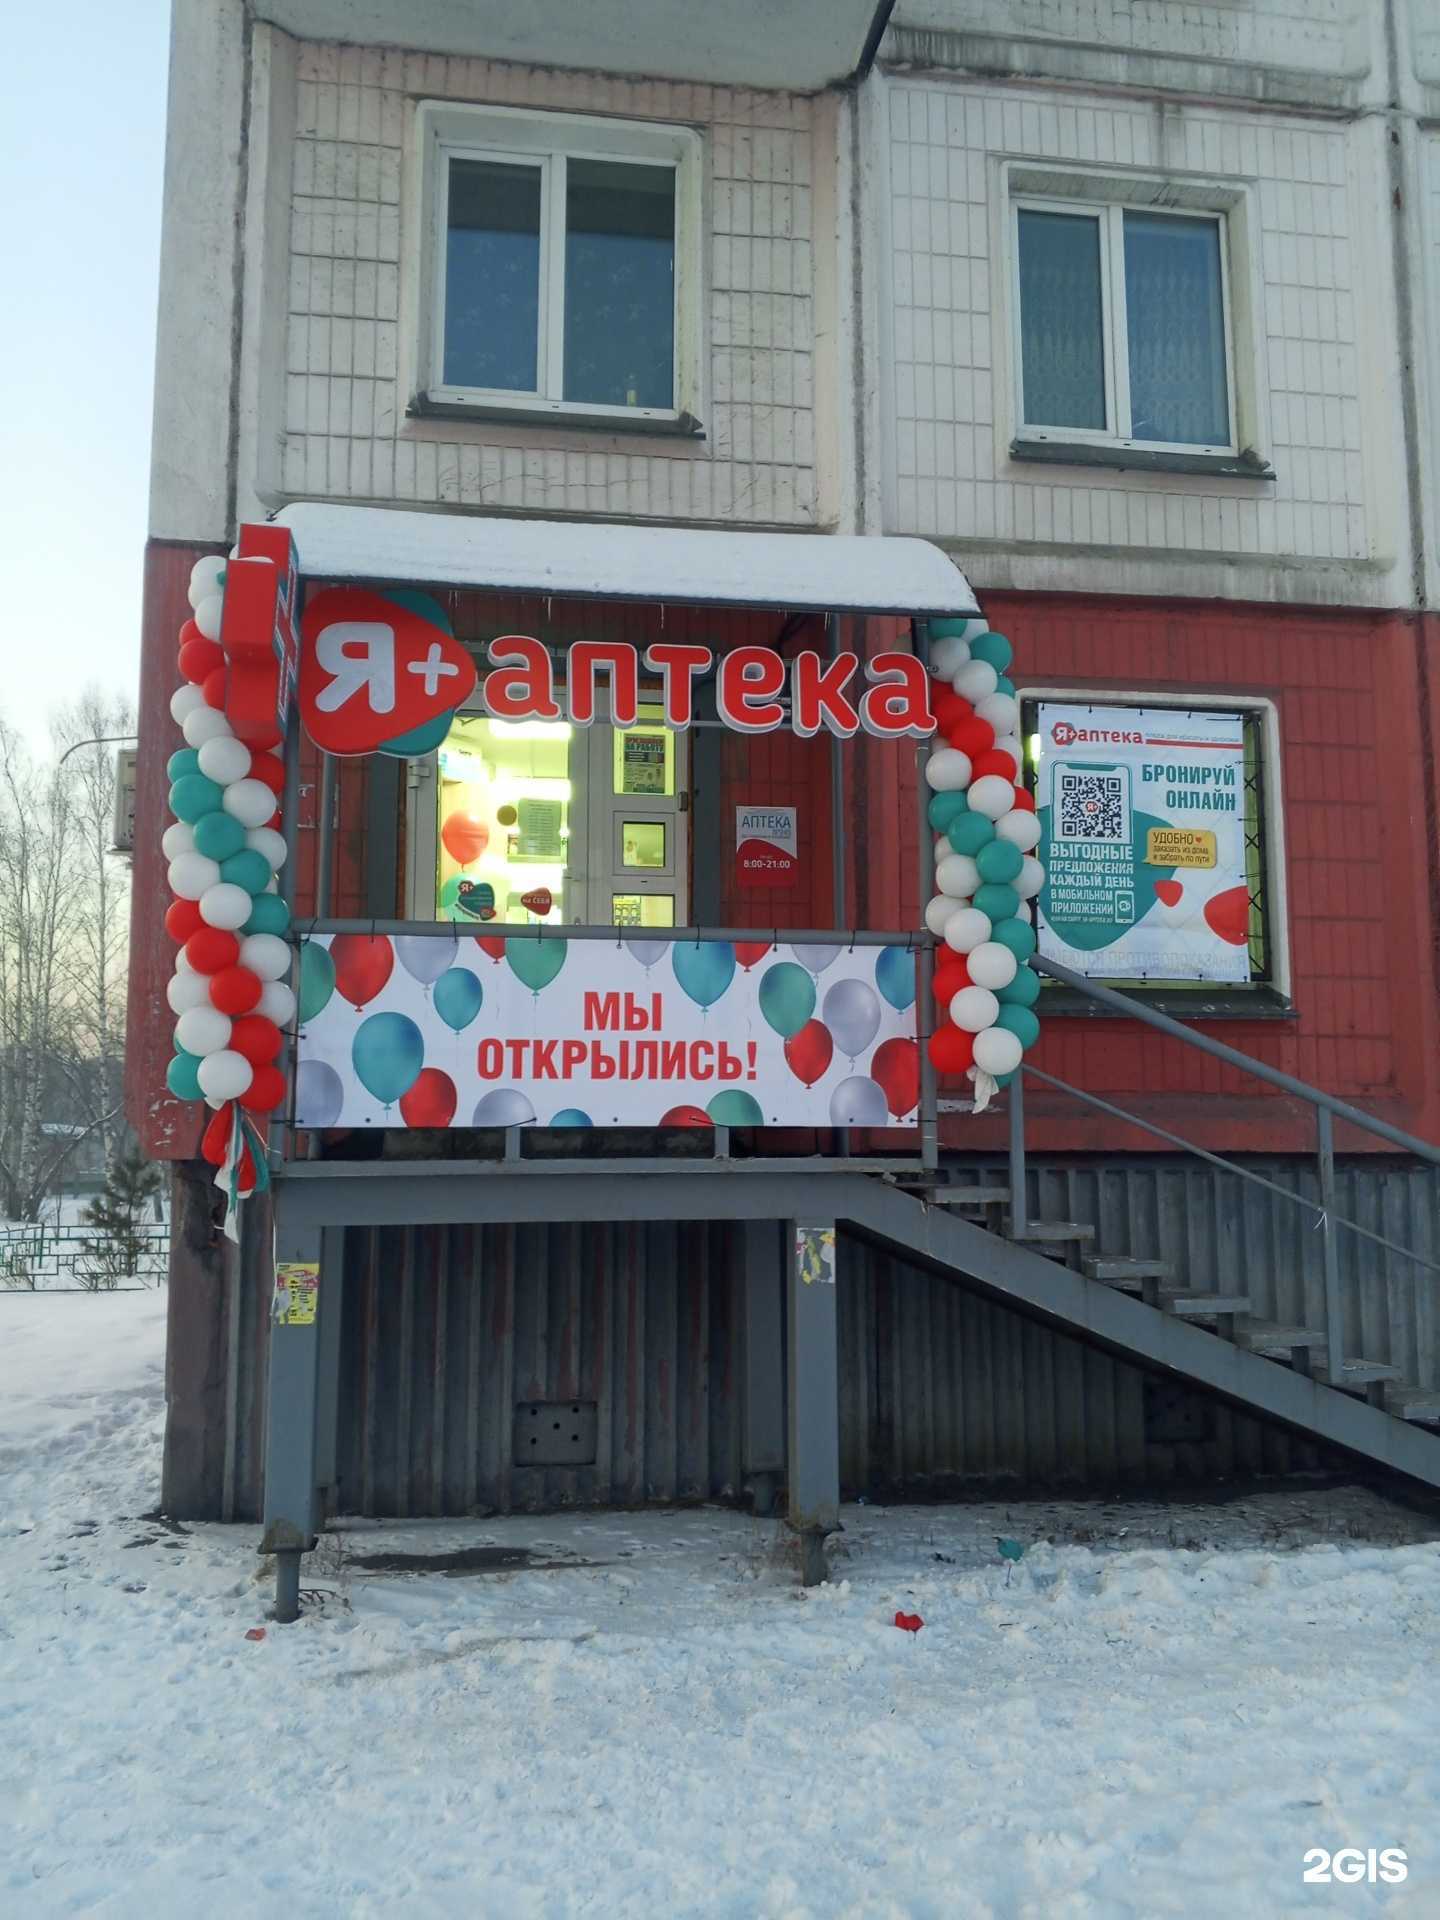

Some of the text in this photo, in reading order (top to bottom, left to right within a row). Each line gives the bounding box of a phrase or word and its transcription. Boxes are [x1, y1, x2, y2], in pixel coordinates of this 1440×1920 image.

[484, 635, 938, 738] аптека
[1078, 728, 1143, 744] аптека
[1142, 764, 1235, 786] БРОНИРУЙ
[1166, 788, 1236, 811] ОНЛАЙН
[742, 815, 792, 829] АПТЕКА
[1153, 832, 1194, 845] УДОБНО
[1050, 843, 1134, 860] ВЫГОДНЫЕ
[1050, 860, 1134, 874] ПРЕДЛОЖЕНИЯ
[1050, 872, 1134, 888] КАЖДЫЙ ДЕНЬ
[1051, 889, 1113, 900] В МОБИЛЬНОМ
[1051, 902, 1113, 915] ПРИЛОЖЕНИИ
[584, 991, 662, 1031] МЫ
[477, 1038, 757, 1080] ОТКРЫЛИСЬ!
